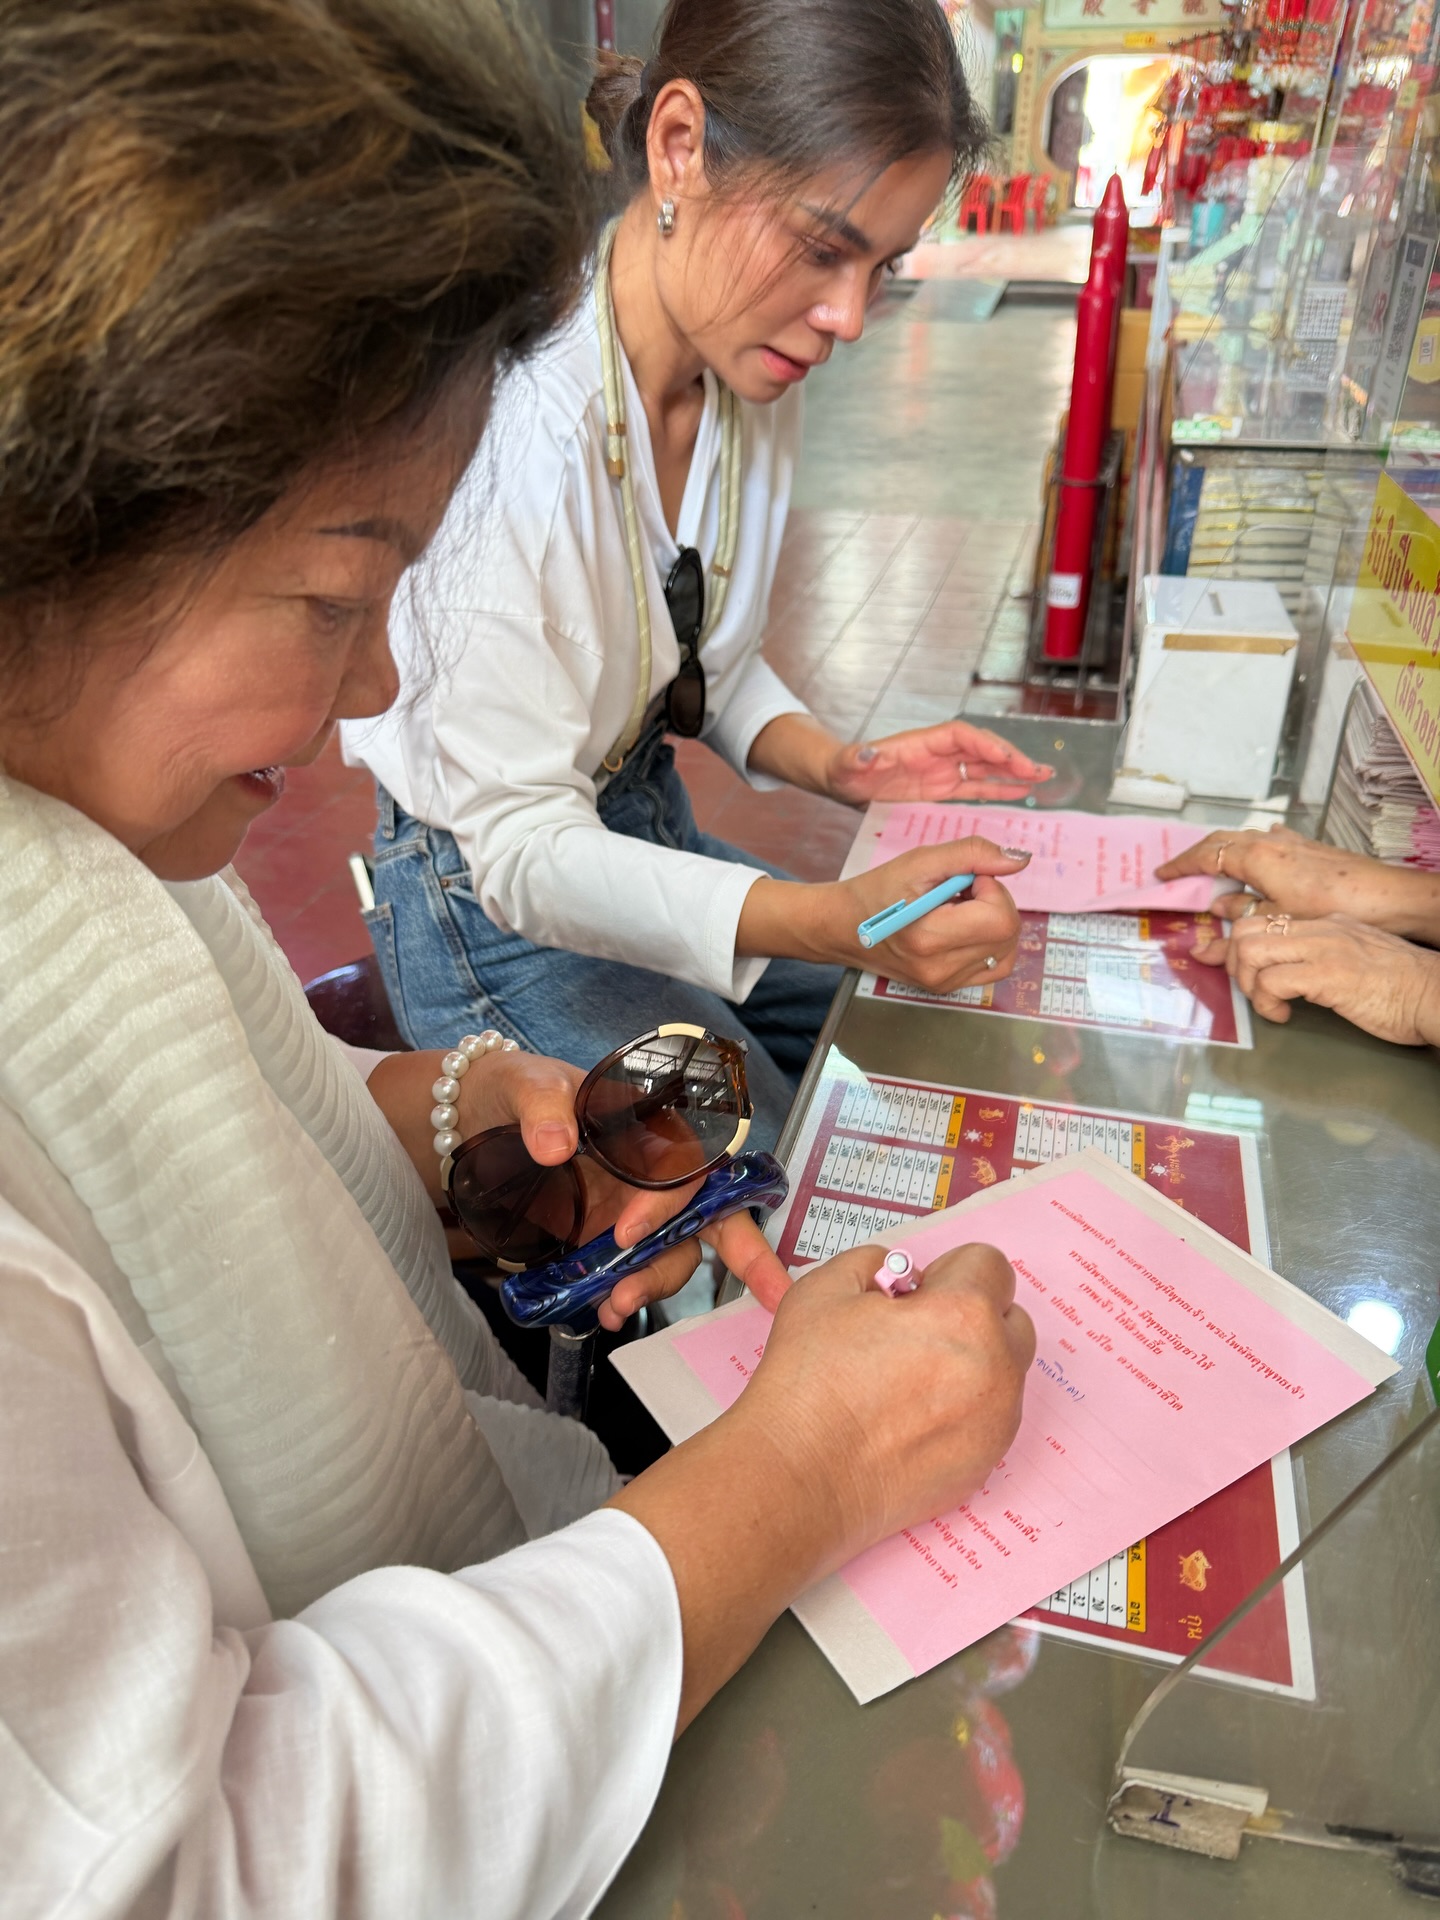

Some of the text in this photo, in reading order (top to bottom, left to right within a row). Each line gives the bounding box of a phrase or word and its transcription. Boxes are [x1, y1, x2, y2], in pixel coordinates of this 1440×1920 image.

[1073, 1592, 1085, 1607] 32
[1092, 1597, 1104, 1611] 20
[1127, 1601, 1140, 1625] อายุ
[1179, 1615, 1202, 1639] กุน
